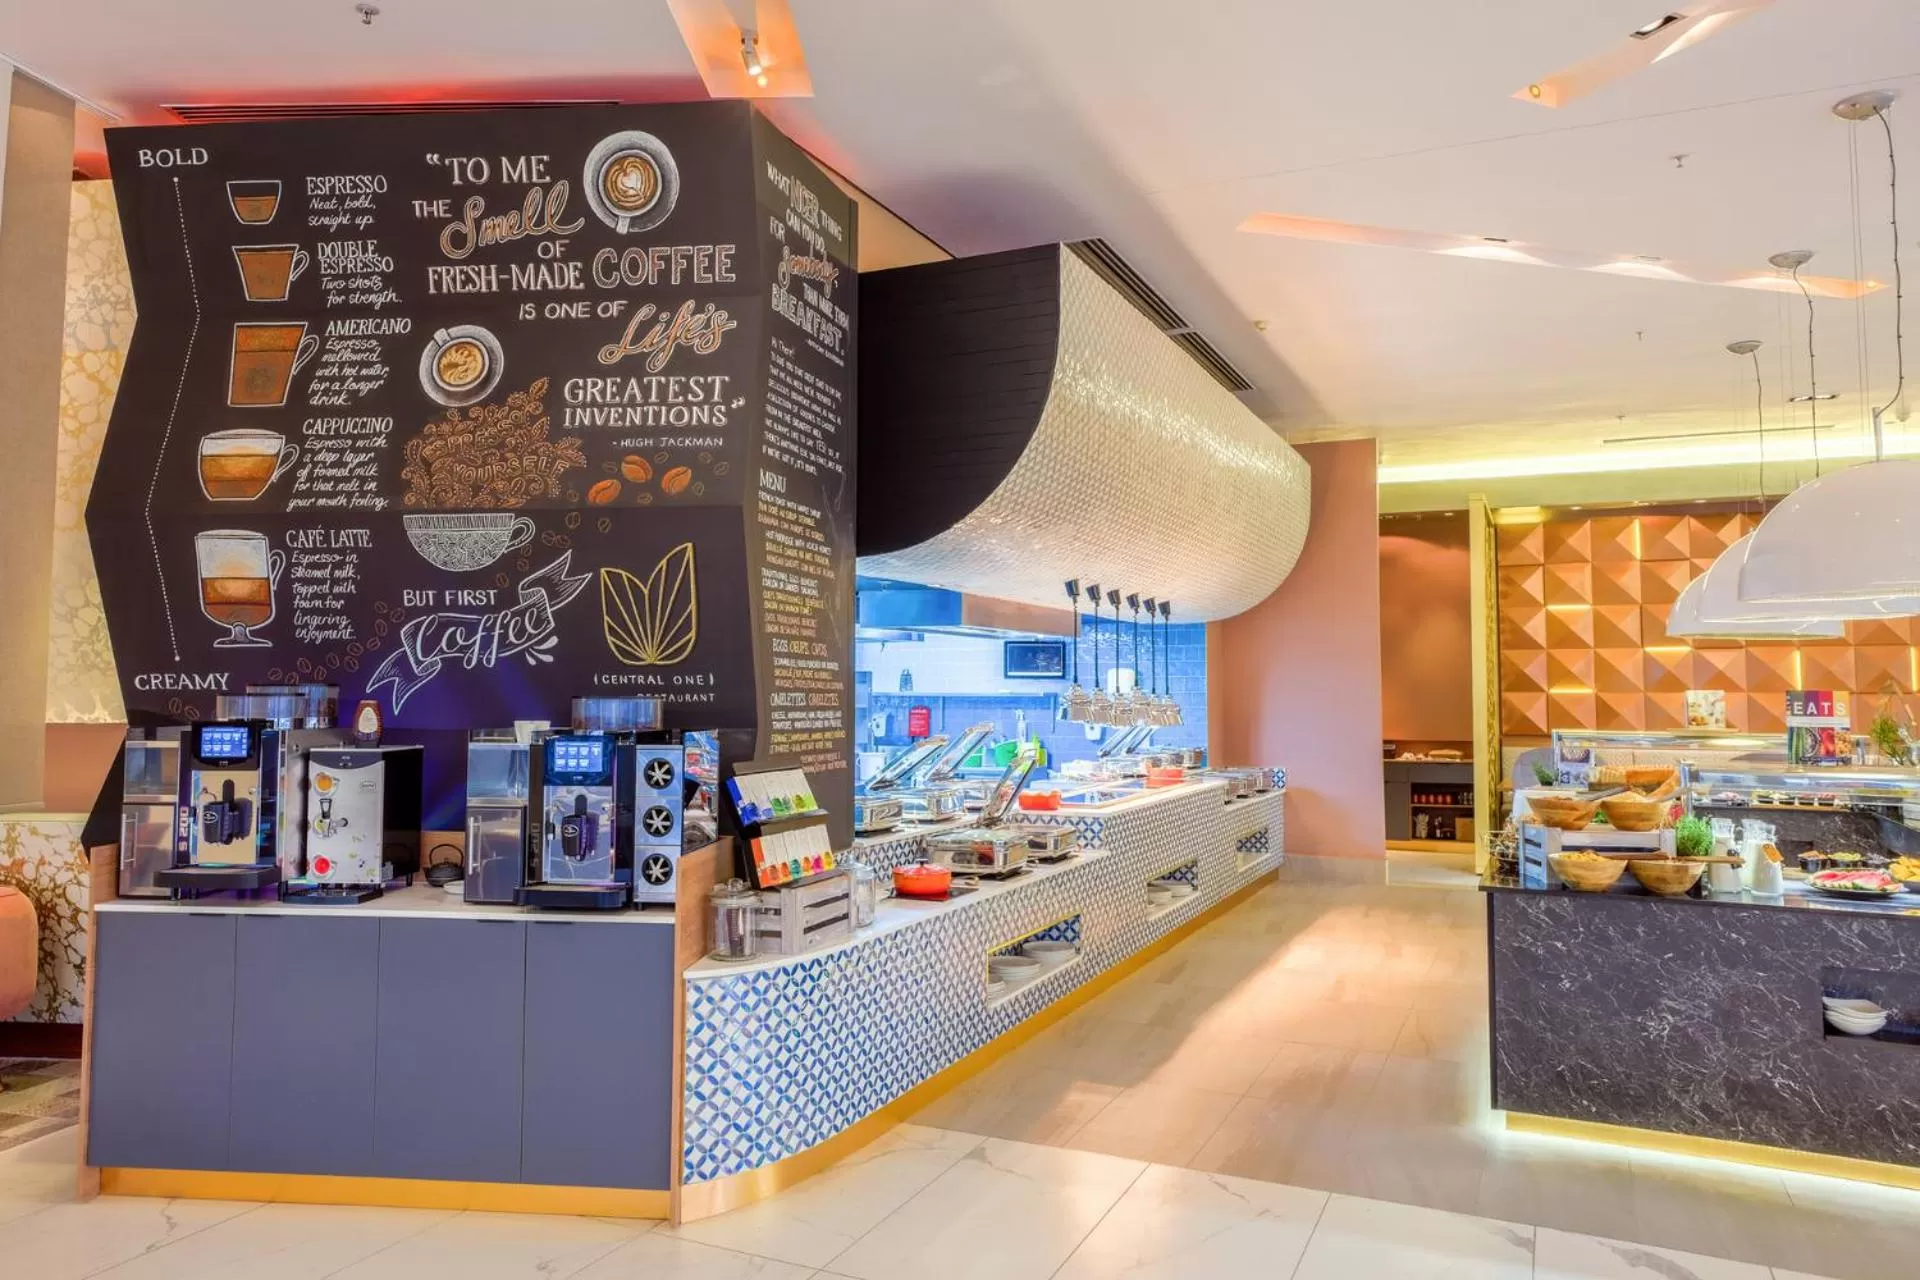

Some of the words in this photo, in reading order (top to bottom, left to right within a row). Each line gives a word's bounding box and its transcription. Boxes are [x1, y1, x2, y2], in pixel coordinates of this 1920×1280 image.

[138, 147, 209, 168] BOLD
[500, 155, 550, 184] ME
[306, 175, 388, 196] ESPRESSO
[412, 199, 453, 219] THE
[766, 161, 790, 197] WHAT
[820, 209, 842, 241] THING
[440, 180, 585, 259] Smell
[770, 215, 785, 244] FOR
[317, 240, 378, 260] DOUBLE
[537, 239, 571, 259] OF
[319, 256, 395, 275] ESPRESSO
[427, 262, 585, 294] FRESH-MADE
[593, 244, 737, 289] COFFEE
[321, 277, 346, 290] Two
[348, 275, 383, 290] shots
[327, 291, 346, 308] for
[519, 302, 536, 320] IS
[544, 301, 591, 319] ONE
[597, 300, 628, 318] OF
[325, 318, 412, 337] AMERICANO
[315, 363, 339, 377] with
[308, 379, 329, 394] for
[342, 378, 385, 397] longer
[563, 375, 730, 404] GREATEST
[302, 416, 393, 436] CAPPUCCINO
[304, 437, 352, 451] Espresso
[355, 433, 389, 449] with
[620, 437, 654, 448] HUGH
[659, 437, 723, 447] JACKMAN
[313, 451, 340, 466] deep
[342, 450, 376, 468] layer
[296, 463, 312, 482] of
[353, 463, 379, 478] milk
[454, 455, 570, 484] YOURSELF
[292, 481, 311, 494] for
[313, 480, 334, 492] that
[336, 478, 360, 492] melt
[363, 480, 378, 492] in
[760, 468, 787, 493] MENU
[286, 495, 316, 513] your
[316, 494, 348, 507] mouth
[286, 524, 327, 548] CAFÉ
[330, 529, 372, 548] LATTE
[291, 550, 342, 566] Espresso
[345, 550, 359, 563] in
[291, 581, 330, 598] topped
[332, 580, 357, 594] with
[403, 590, 434, 607] BUT
[445, 589, 498, 606] FIRST
[292, 595, 324, 609] foam
[325, 597, 345, 610] for
[415, 604, 548, 669] Coffee
[134, 672, 230, 691] CREAMY
[637, 693, 715, 703] TAURANT
[1794, 701, 1845, 715] EATS
